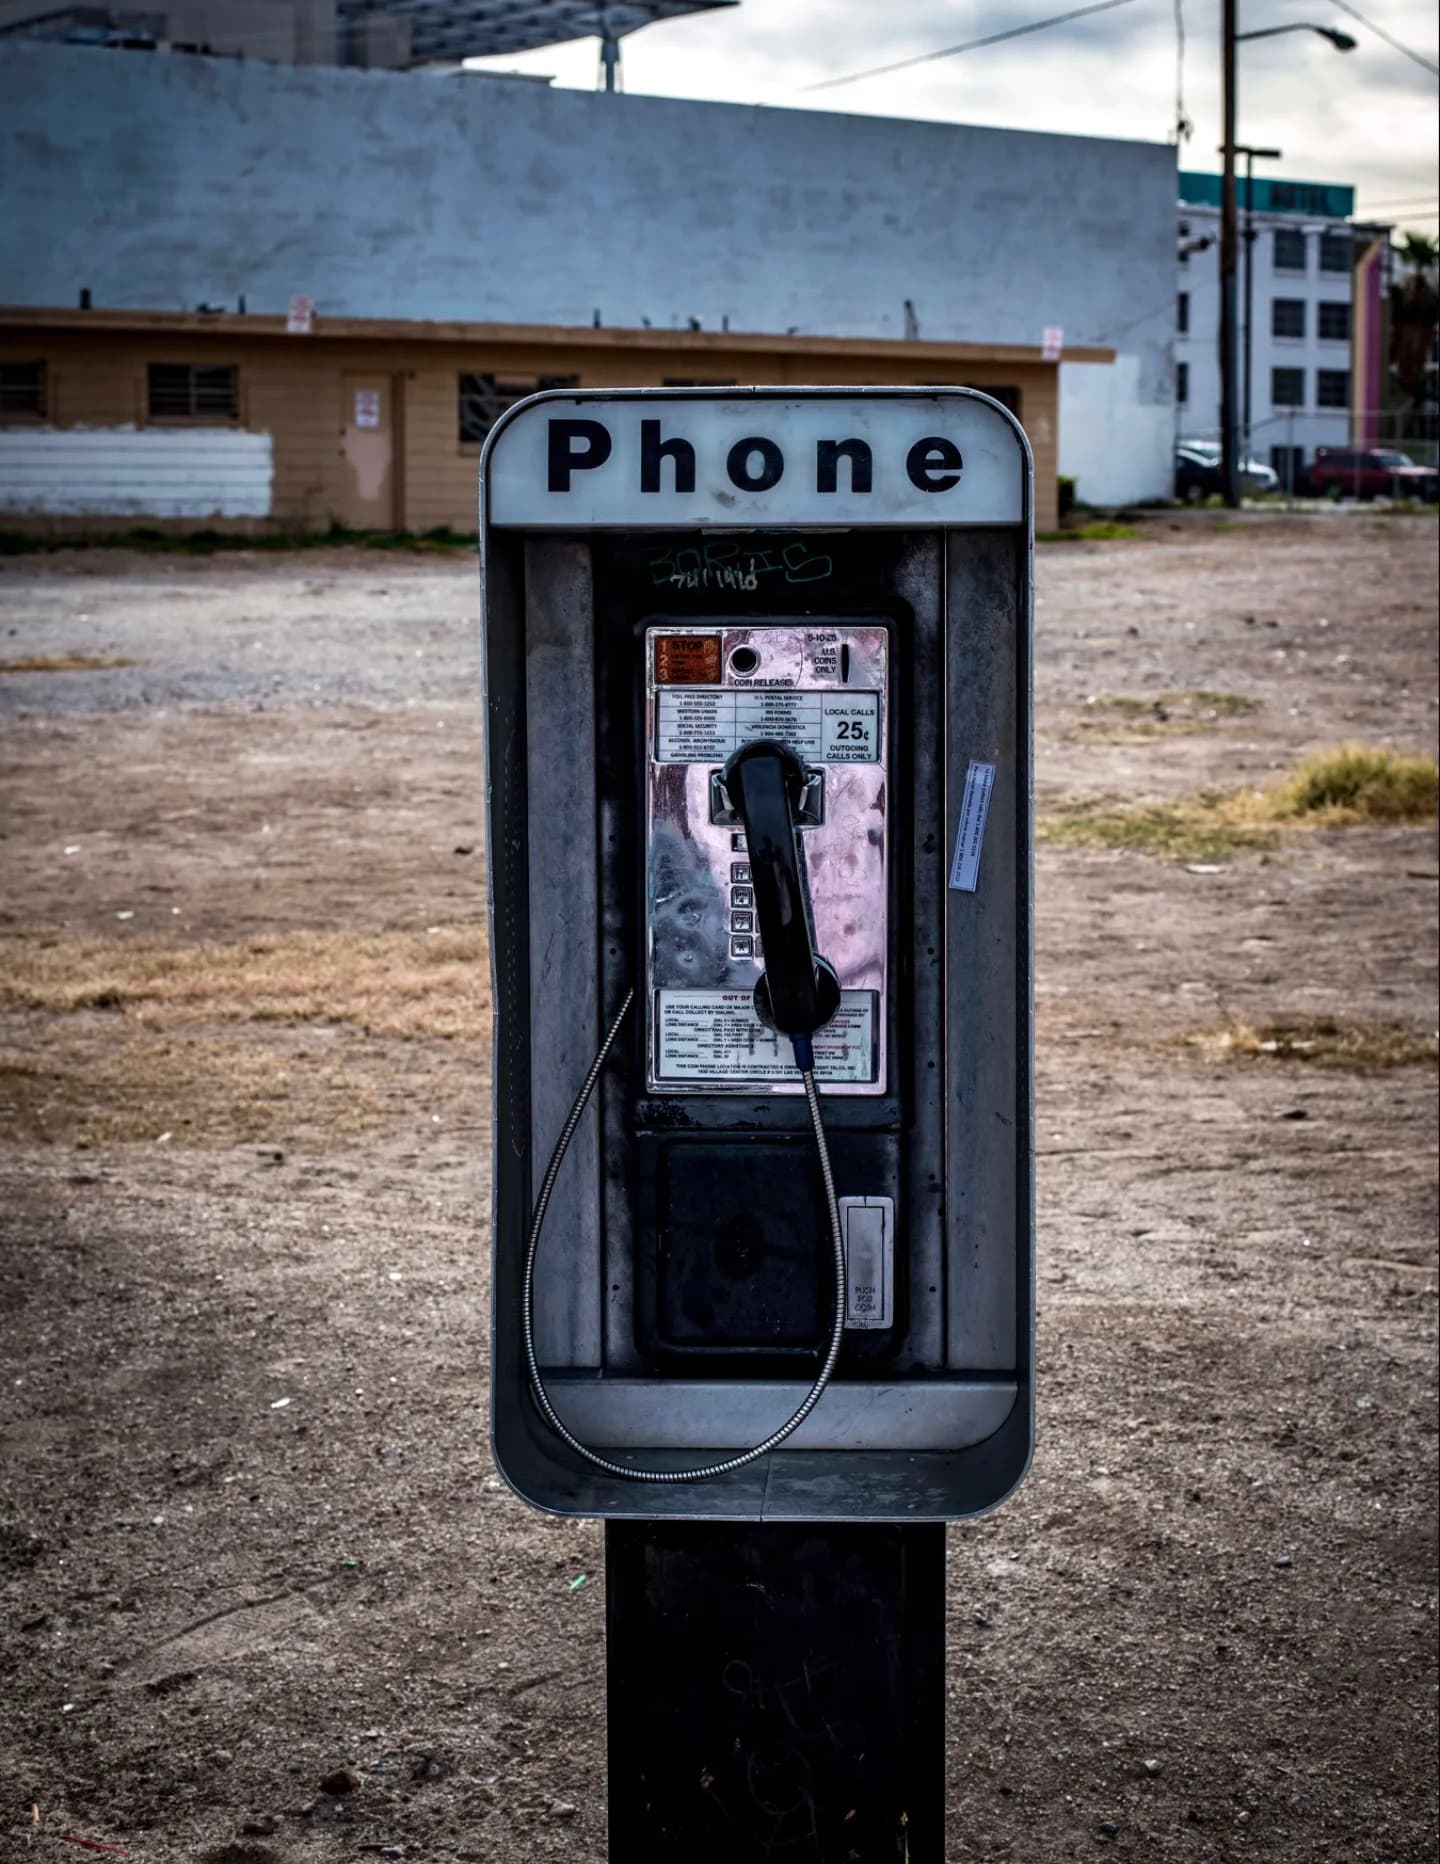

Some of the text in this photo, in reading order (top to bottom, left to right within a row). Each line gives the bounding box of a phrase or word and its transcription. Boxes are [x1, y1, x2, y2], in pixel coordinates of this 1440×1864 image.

[547, 419, 963, 493] Phone
[659, 655, 668, 666] 2
[659, 669, 668, 680] 3
[815, 666, 836, 674] ONLY
[734, 679, 752, 687] COIN
[824, 708, 875, 716] LOCAL CALLS
